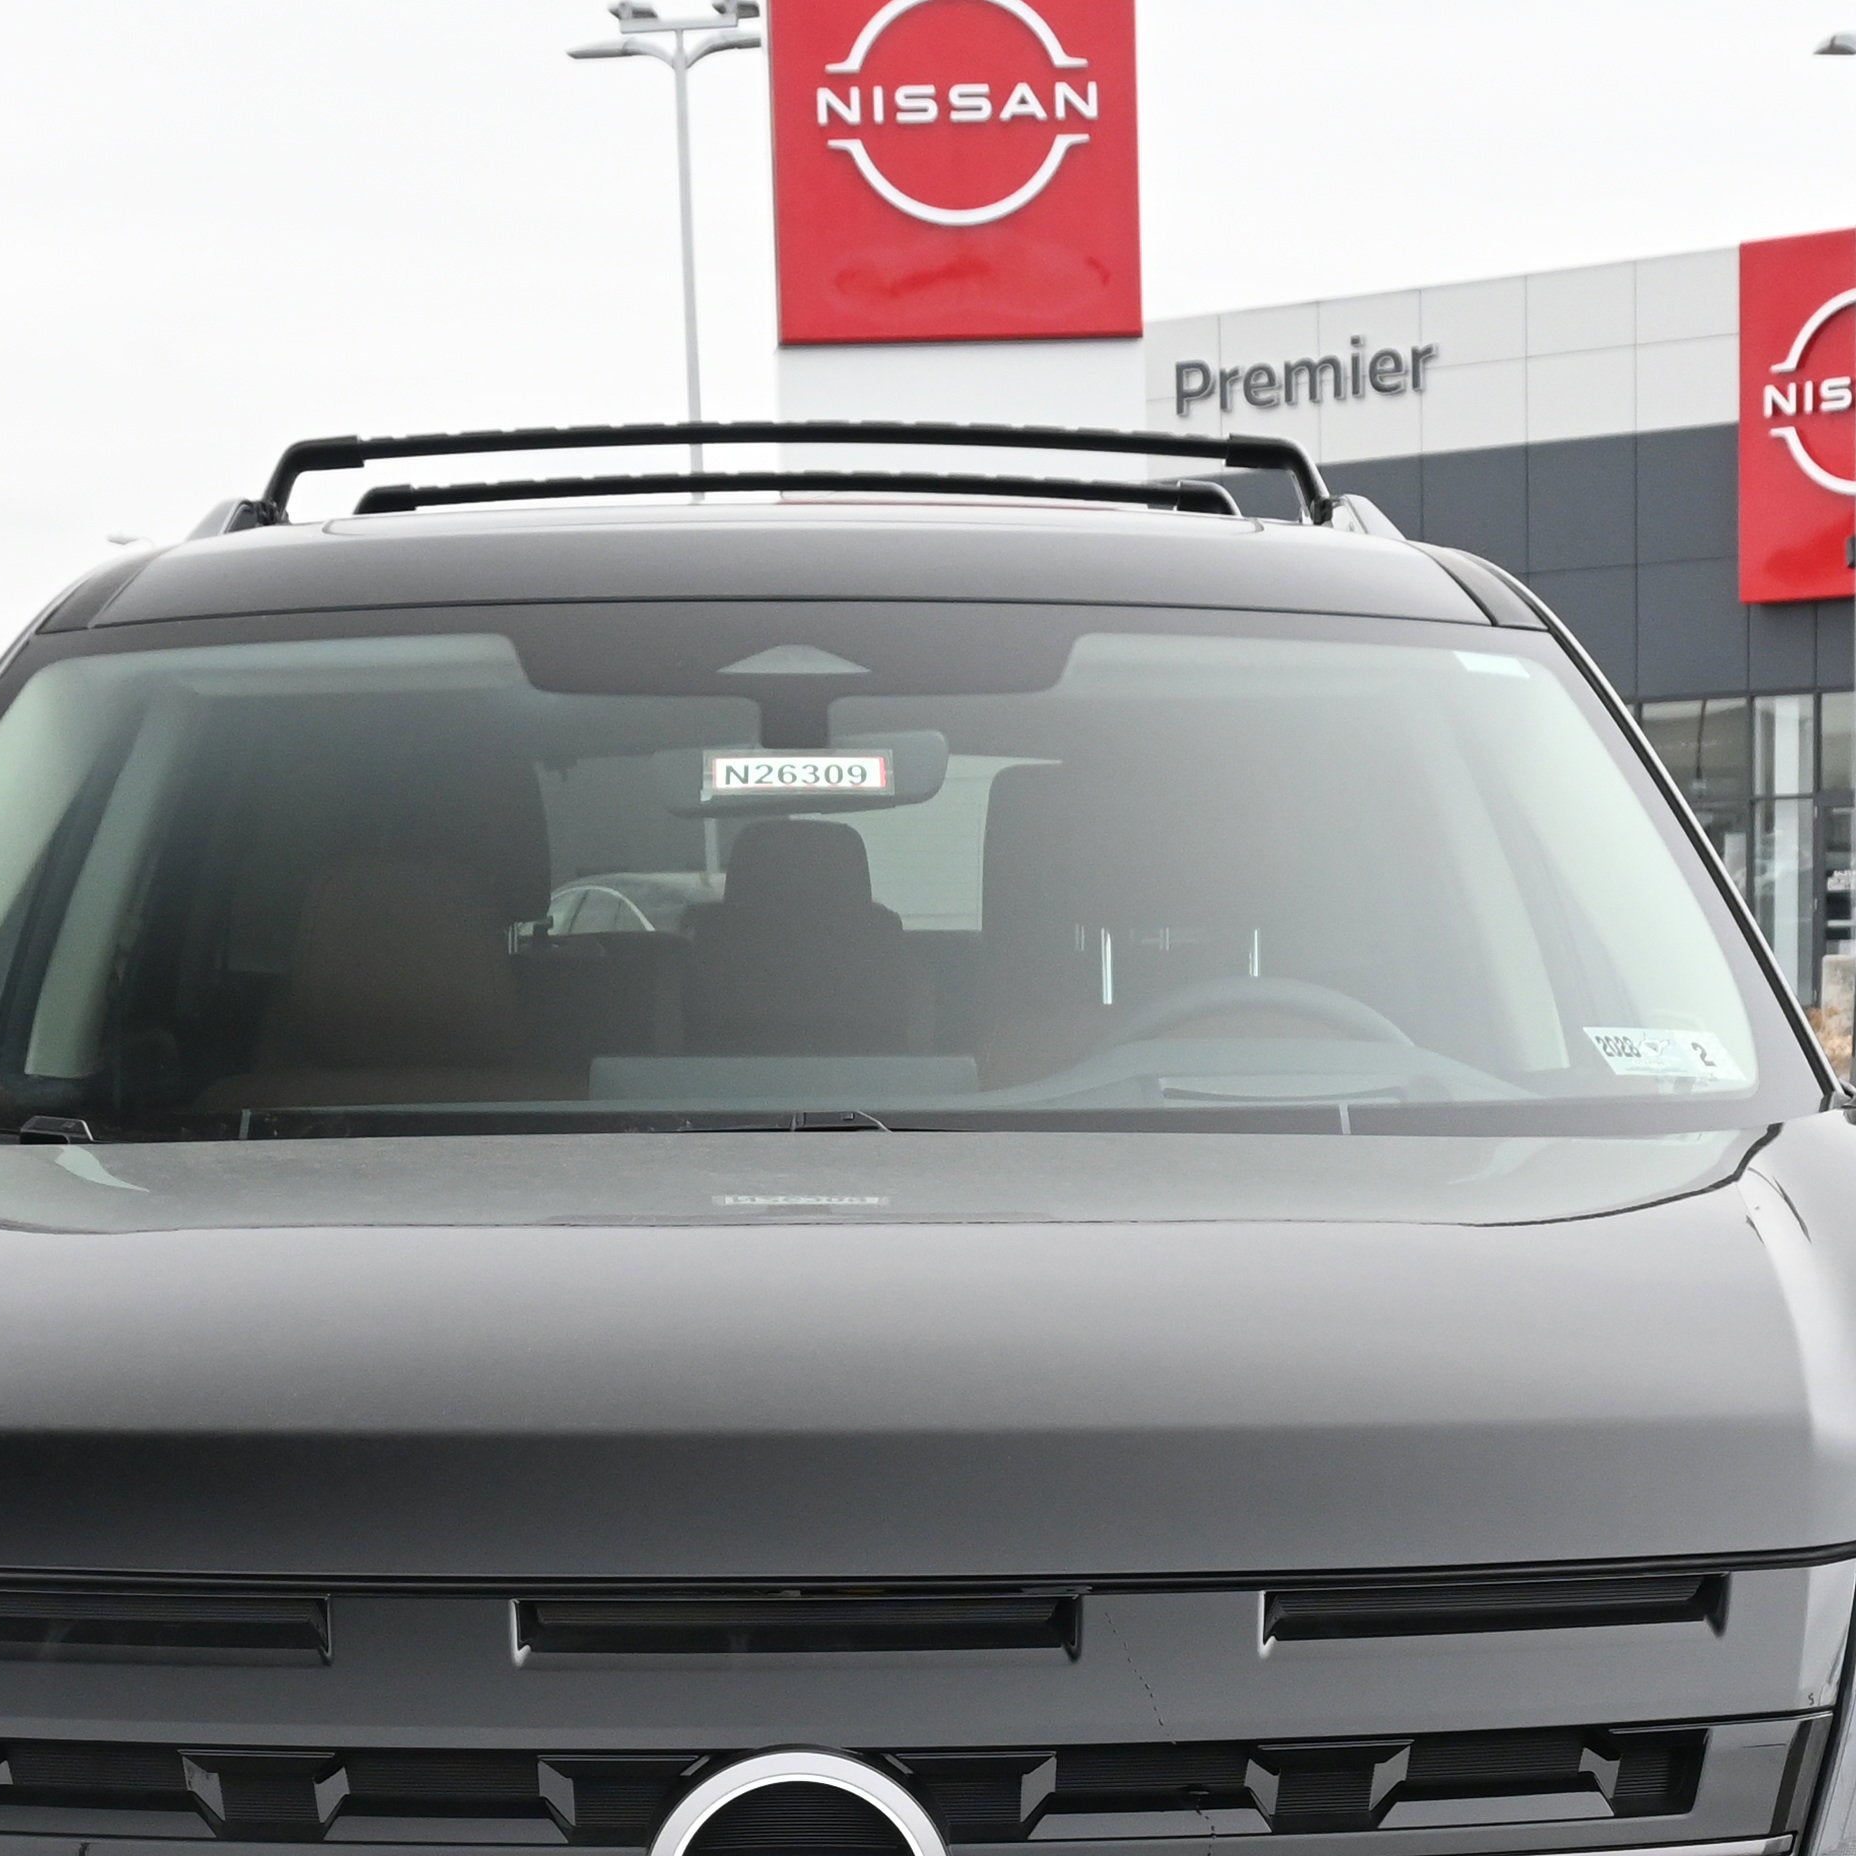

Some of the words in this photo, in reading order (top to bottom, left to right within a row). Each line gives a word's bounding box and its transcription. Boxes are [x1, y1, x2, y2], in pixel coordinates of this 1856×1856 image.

[817, 81, 1099, 125] NISSAN
[1175, 335, 1438, 417] Premier
[725, 763, 867, 785] N26309
[1691, 1041, 1717, 1067] 2
